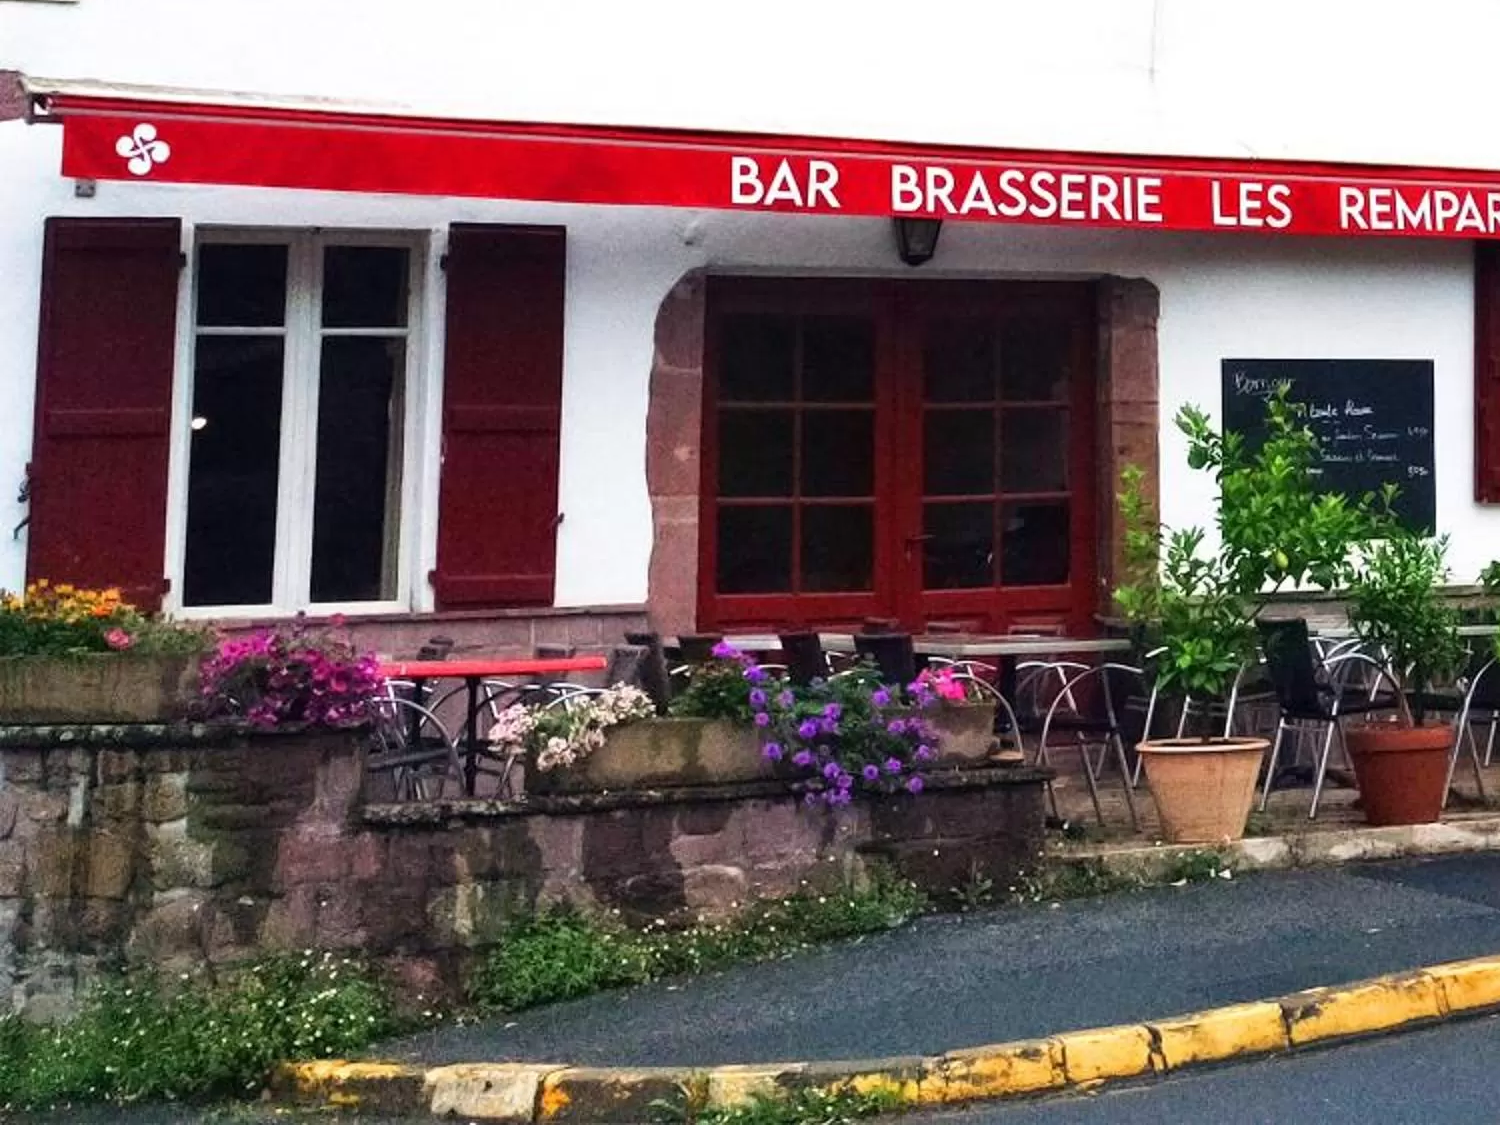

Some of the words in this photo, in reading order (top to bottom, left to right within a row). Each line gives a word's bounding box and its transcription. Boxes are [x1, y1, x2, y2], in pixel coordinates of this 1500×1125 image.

[731, 156, 841, 208] BAR
[891, 164, 1163, 223] BRASSERIE
[1211, 180, 1293, 228] LES
